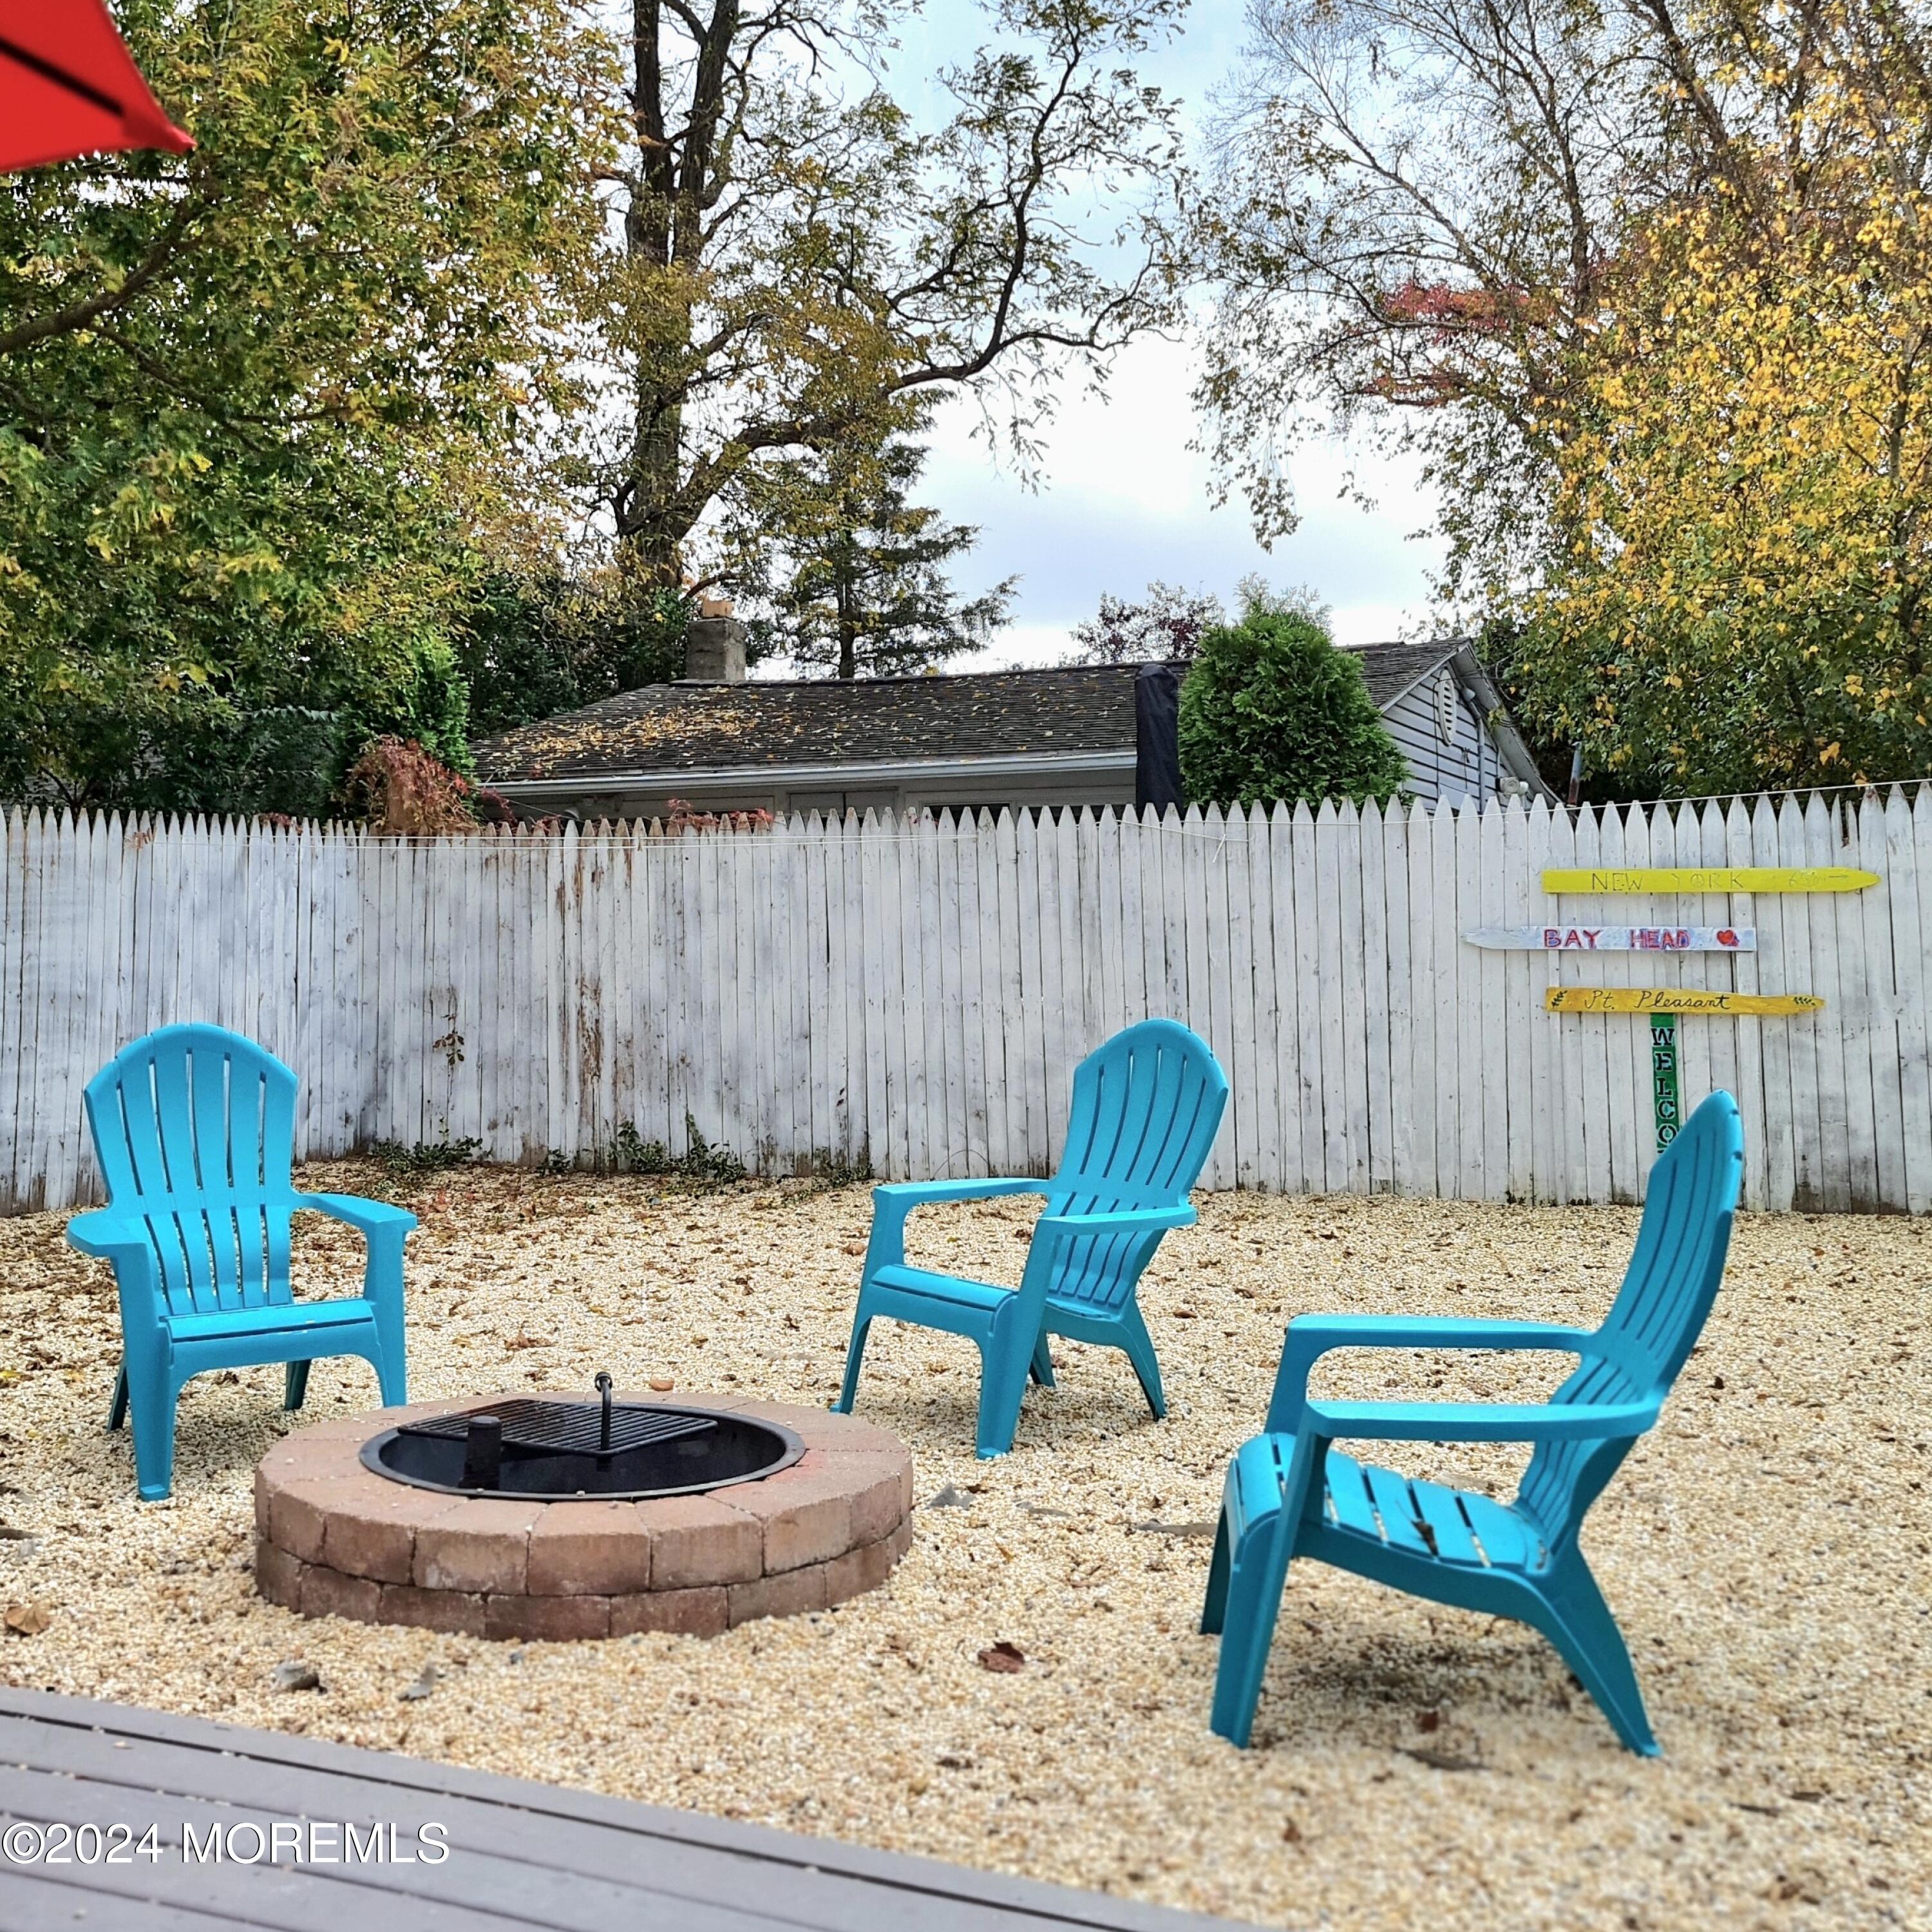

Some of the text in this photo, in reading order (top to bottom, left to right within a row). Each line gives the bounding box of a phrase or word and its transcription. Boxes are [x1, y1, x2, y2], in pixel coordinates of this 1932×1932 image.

[1591, 872, 1643, 891] NEW
[1671, 871, 1744, 889] YORK
[1544, 928, 1691, 950] BAY HEAD
[1584, 990, 1731, 1010] Pt. Pleasant
[1650, 1027, 1677, 1154] WELCO
